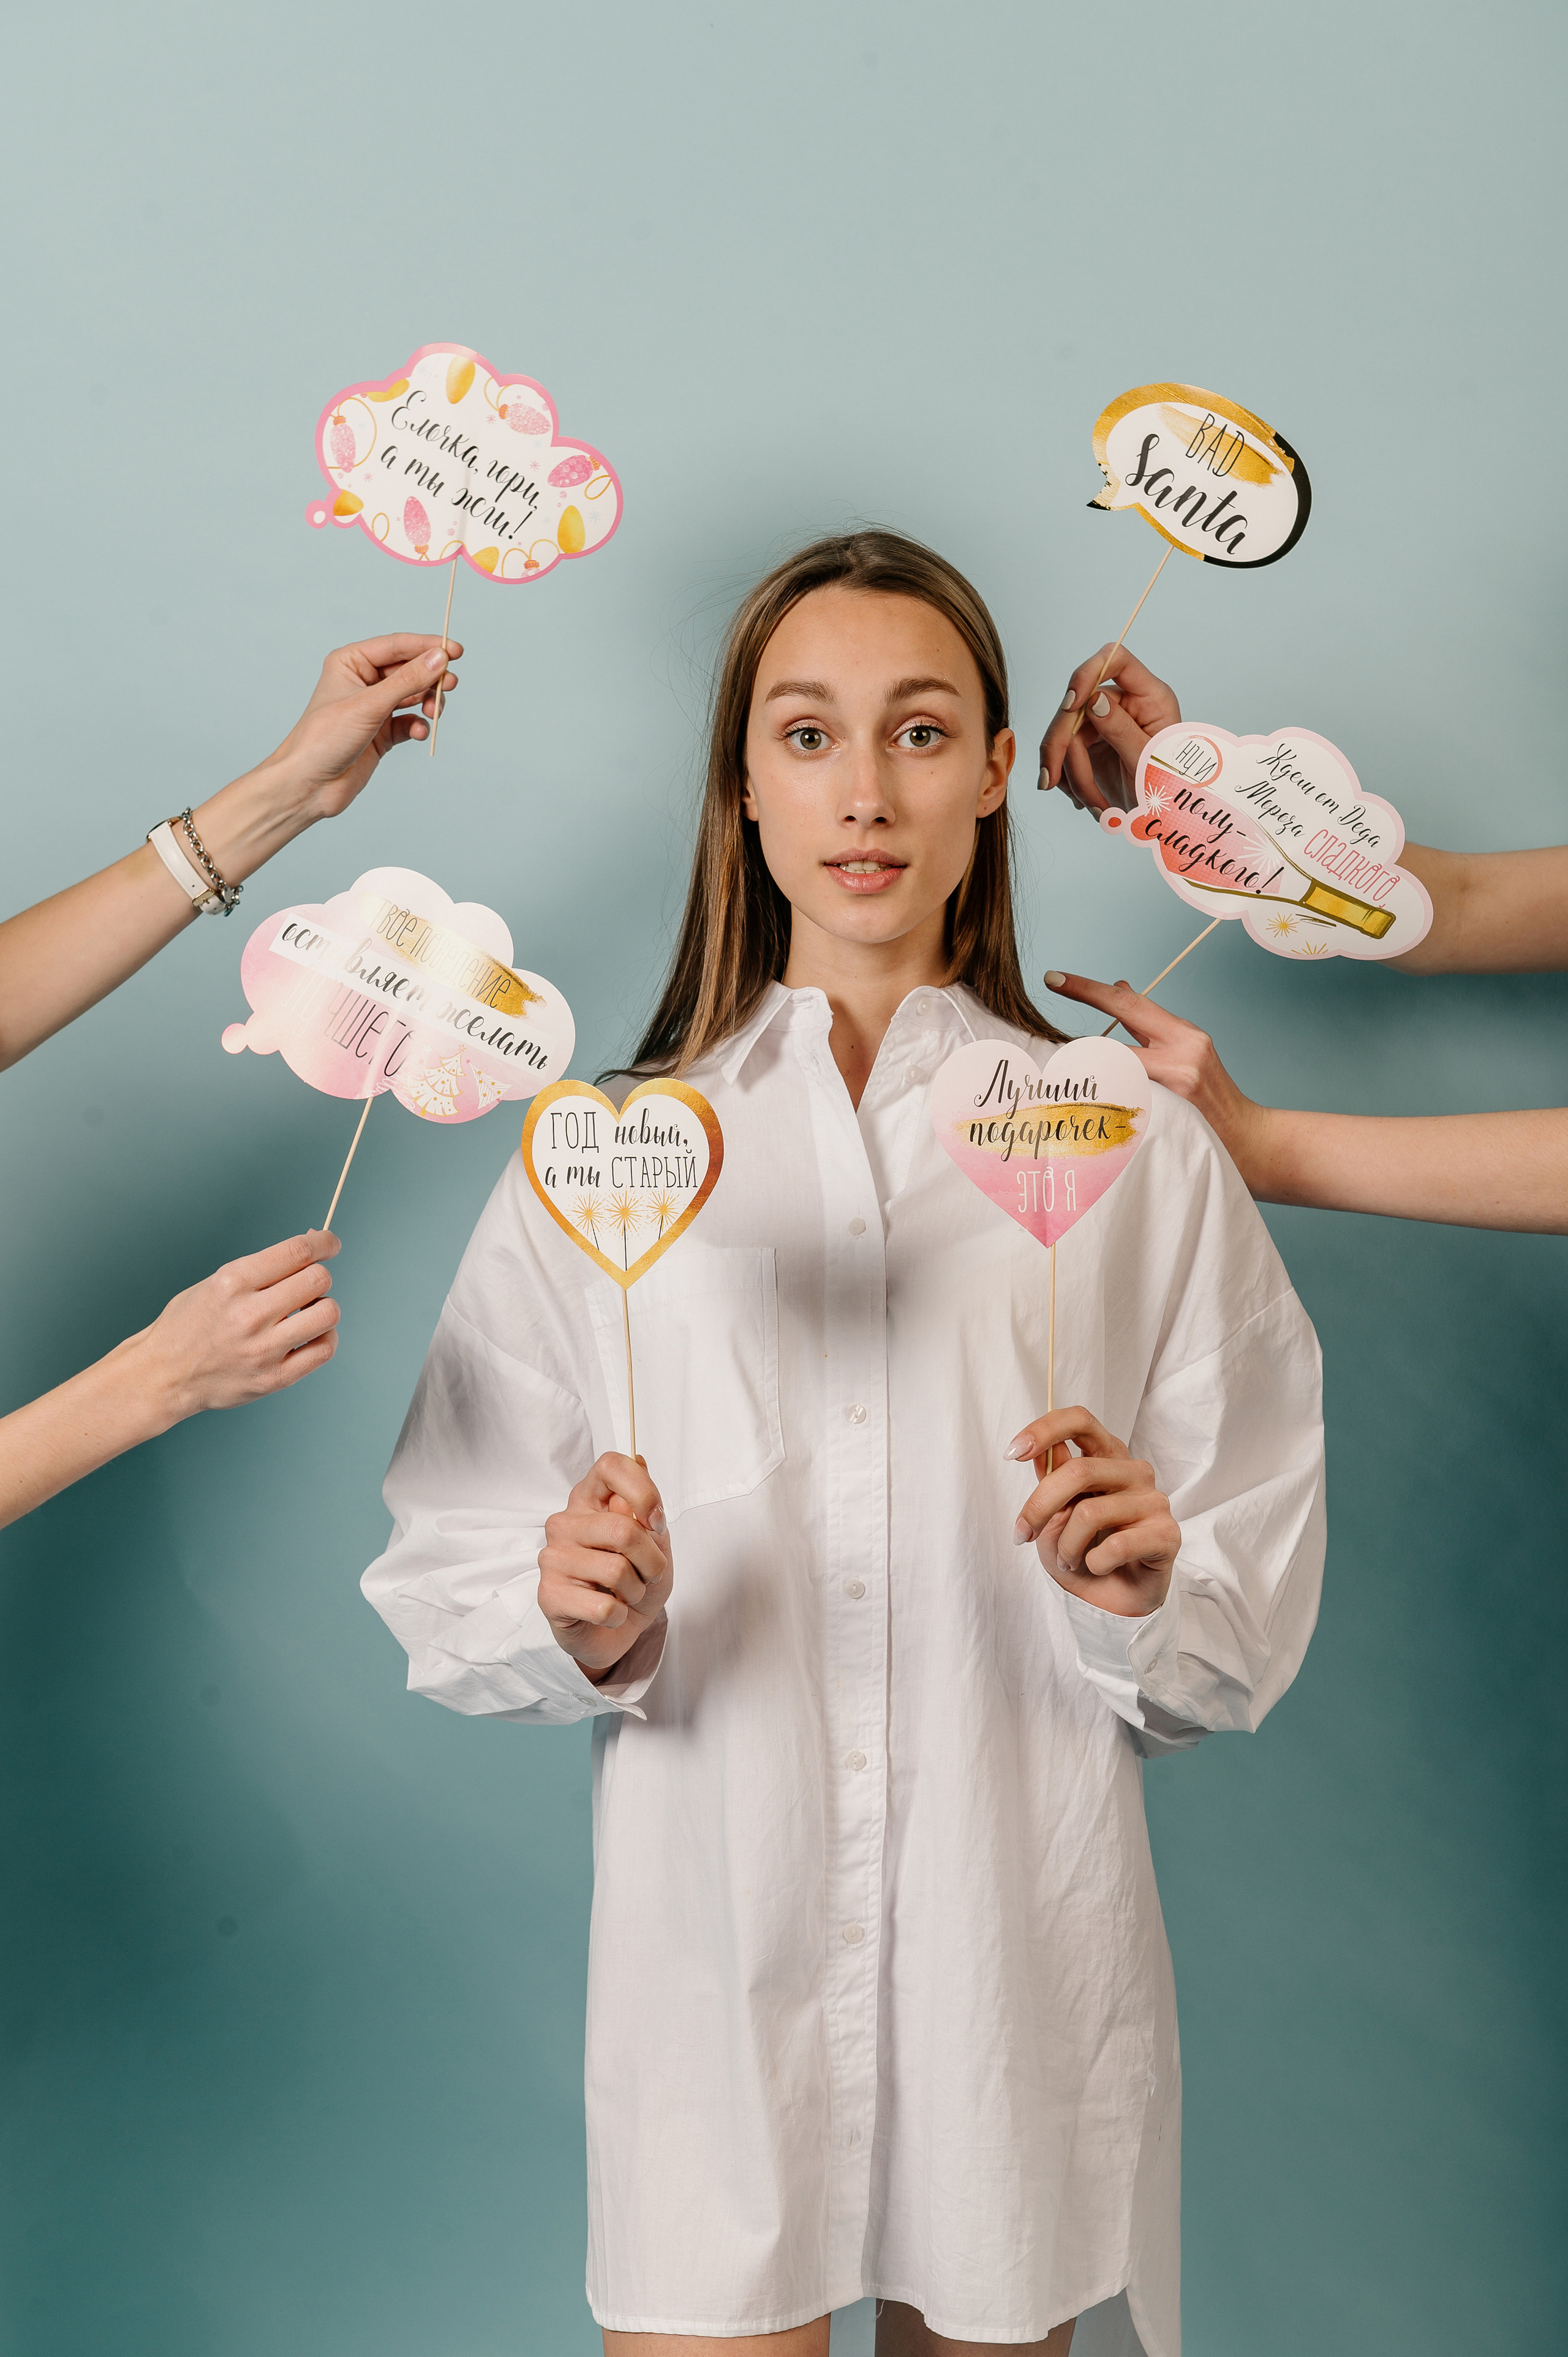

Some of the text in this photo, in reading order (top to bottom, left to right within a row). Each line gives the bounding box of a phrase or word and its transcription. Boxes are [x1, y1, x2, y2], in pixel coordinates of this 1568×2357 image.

[391, 390, 540, 512] Елочка, гори,
[1185, 413, 1245, 477] BAD
[380, 445, 533, 539] а ты жги!
[1125, 433, 1248, 554] Santa
[1234, 781, 1306, 838] Мороза
[1315, 792, 1340, 814] от
[1337, 804, 1381, 848] Деда
[1145, 819, 1284, 895] сладкого!
[282, 923, 548, 1070] оствляет желать
[974, 1059, 1099, 1119] Лучший
[551, 1108, 688, 1153] ГОД новый,
[545, 1149, 698, 1188] а ты СТАРЫЙ
[1016, 1167, 1077, 1213] ЭТО Я
